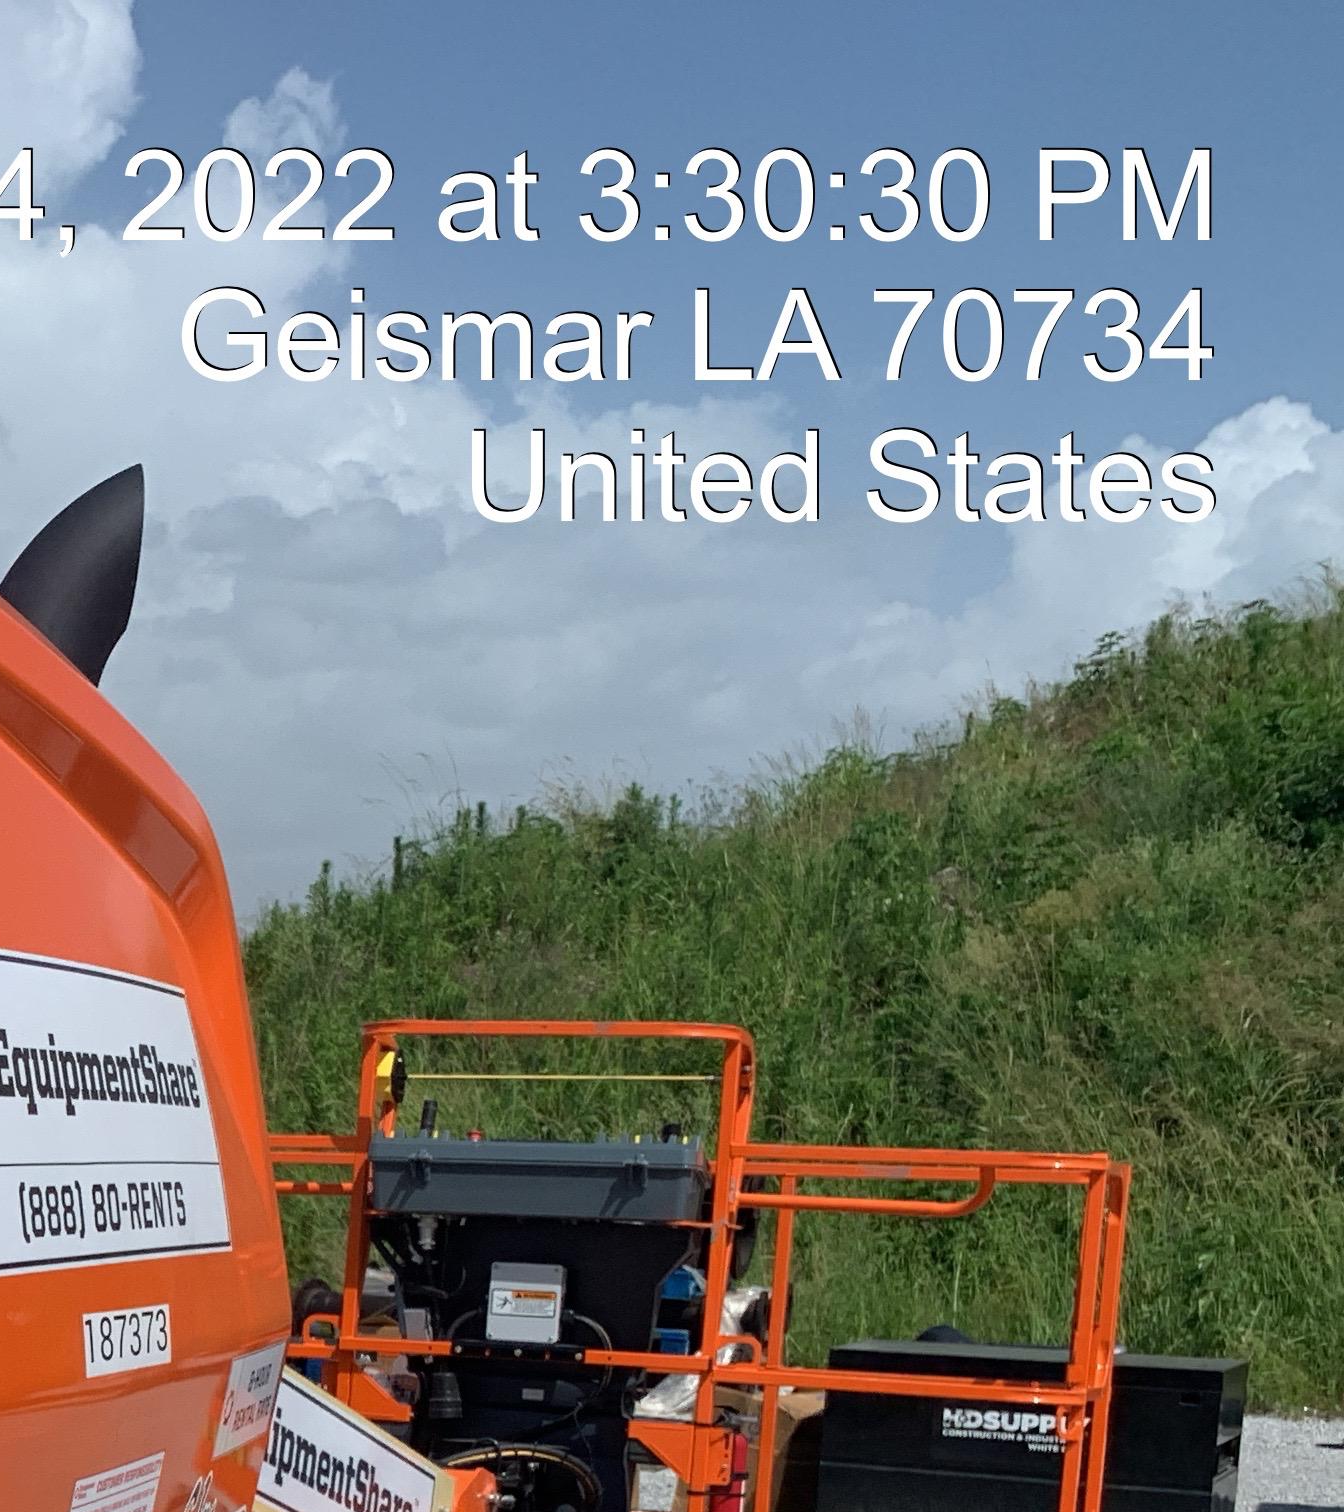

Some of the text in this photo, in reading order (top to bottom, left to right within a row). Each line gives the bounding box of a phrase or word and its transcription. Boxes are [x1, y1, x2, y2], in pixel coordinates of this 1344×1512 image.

[18, 1179, 187, 1244] (888) 80-RENTS
[84, 1308, 169, 1365] 187373
[942, 1428, 1016, 1443] CONSTRUCTION
[1027, 1442, 1059, 1453] WHITE
